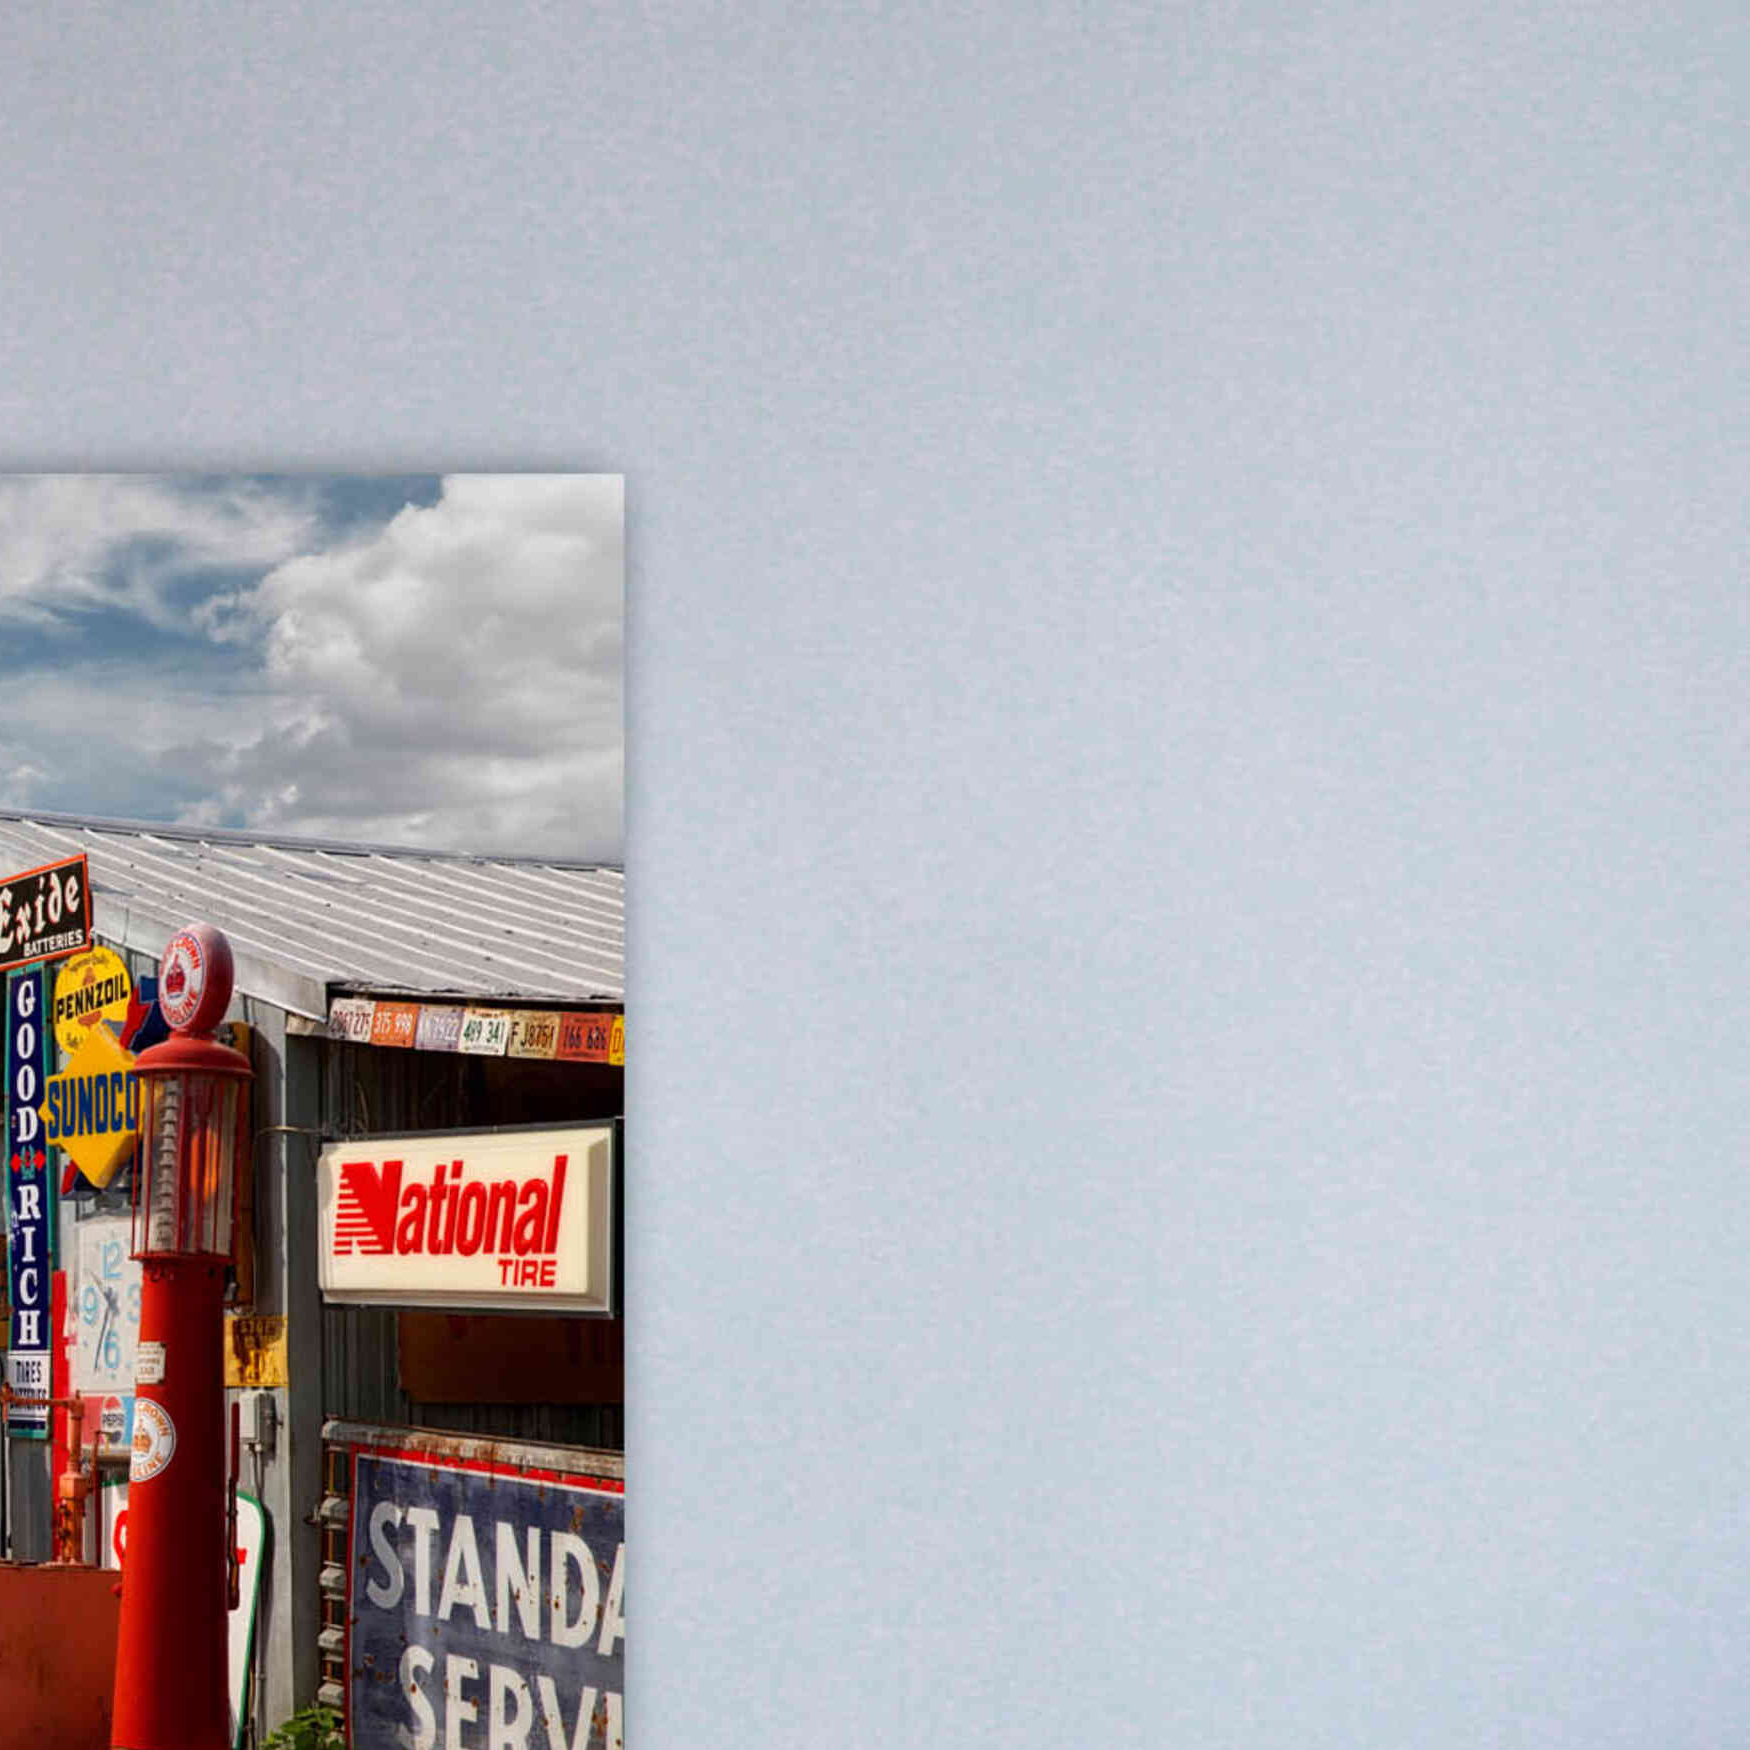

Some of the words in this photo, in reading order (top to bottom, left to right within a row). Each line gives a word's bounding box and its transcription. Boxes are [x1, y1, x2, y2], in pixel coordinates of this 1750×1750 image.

[23, 929, 83, 957] BATTERIES
[56, 973, 128, 1023] PENNZOIL
[48, 1070, 136, 1140] SUNOCO
[333, 1154, 569, 1256] National
[101, 1241, 123, 1279] 12
[497, 1259, 557, 1287] TIRE
[81, 1285, 99, 1325] 9
[103, 1330, 122, 1369] 6
[15, 1361, 41, 1383] TIRES
